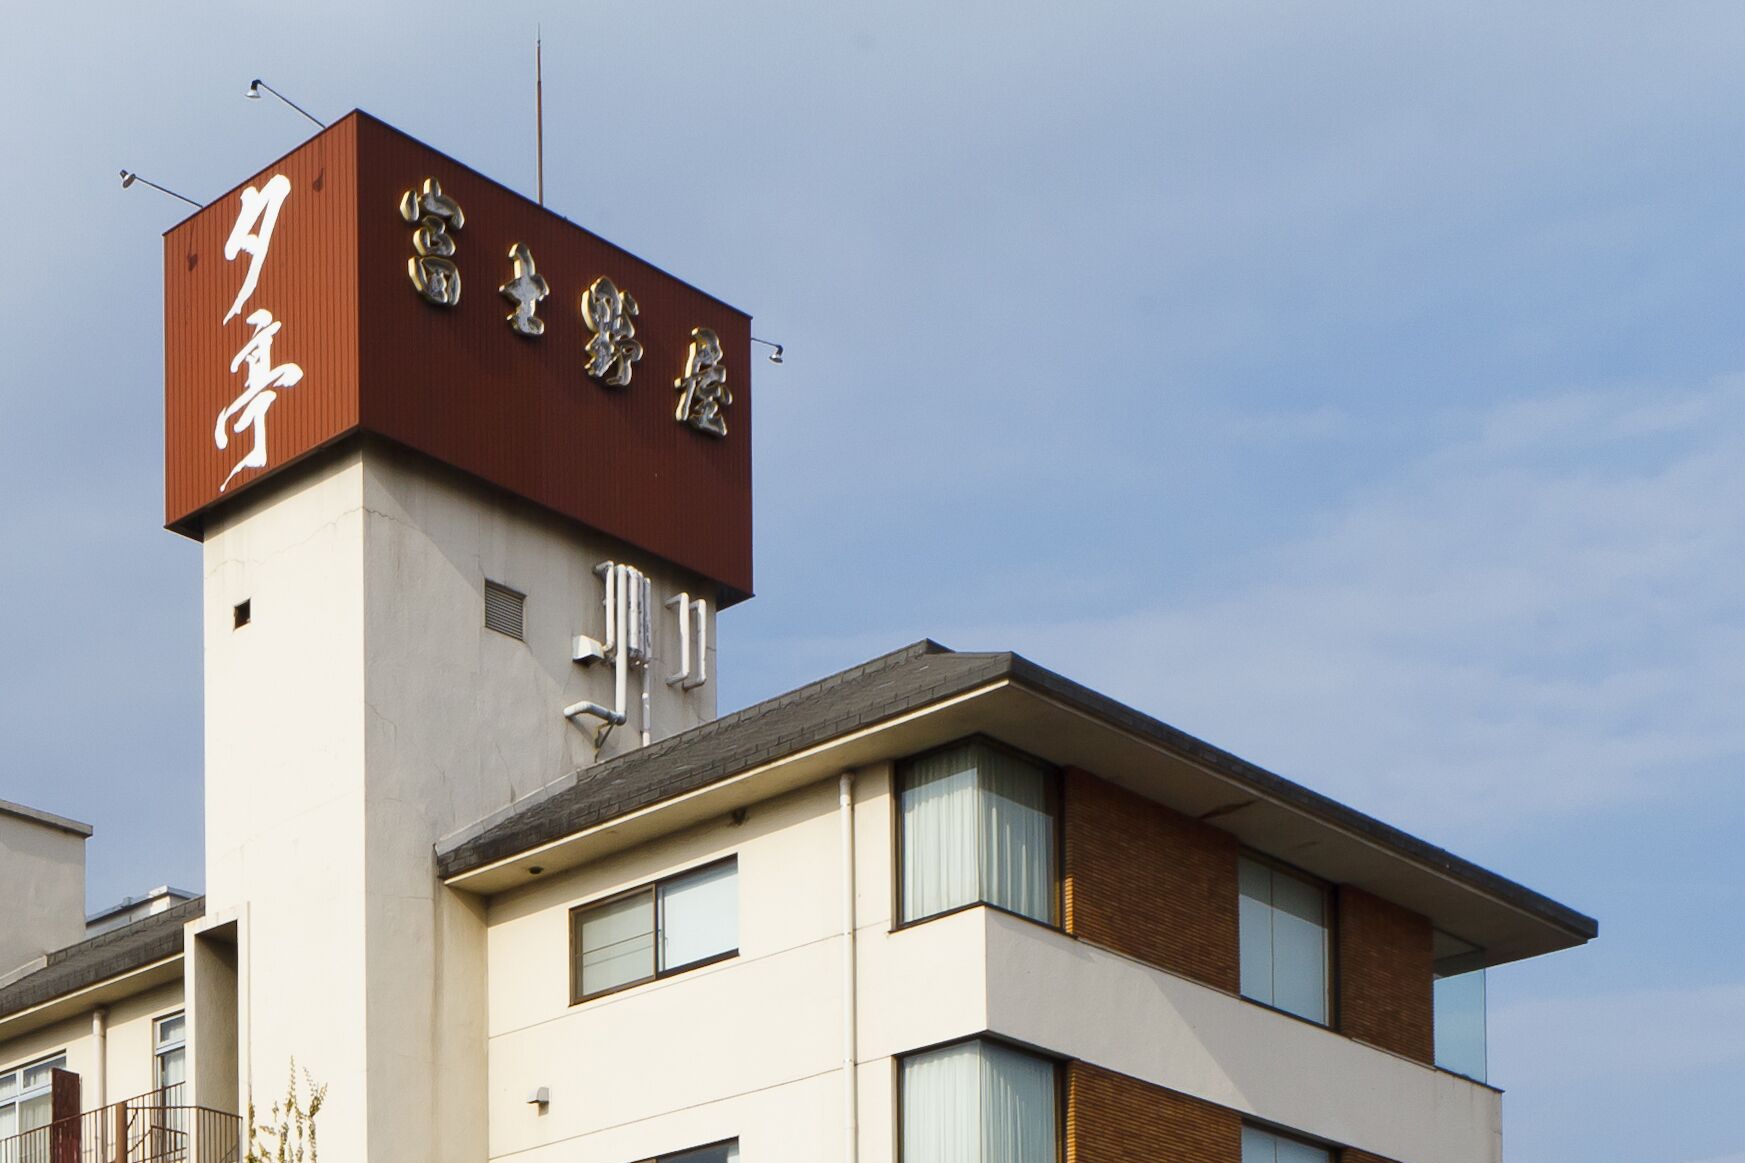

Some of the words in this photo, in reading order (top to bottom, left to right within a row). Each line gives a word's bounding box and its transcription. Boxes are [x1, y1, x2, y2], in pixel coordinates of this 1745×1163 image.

[214, 174, 303, 492] 夕亭
[399, 177, 733, 438] 富士野屋
